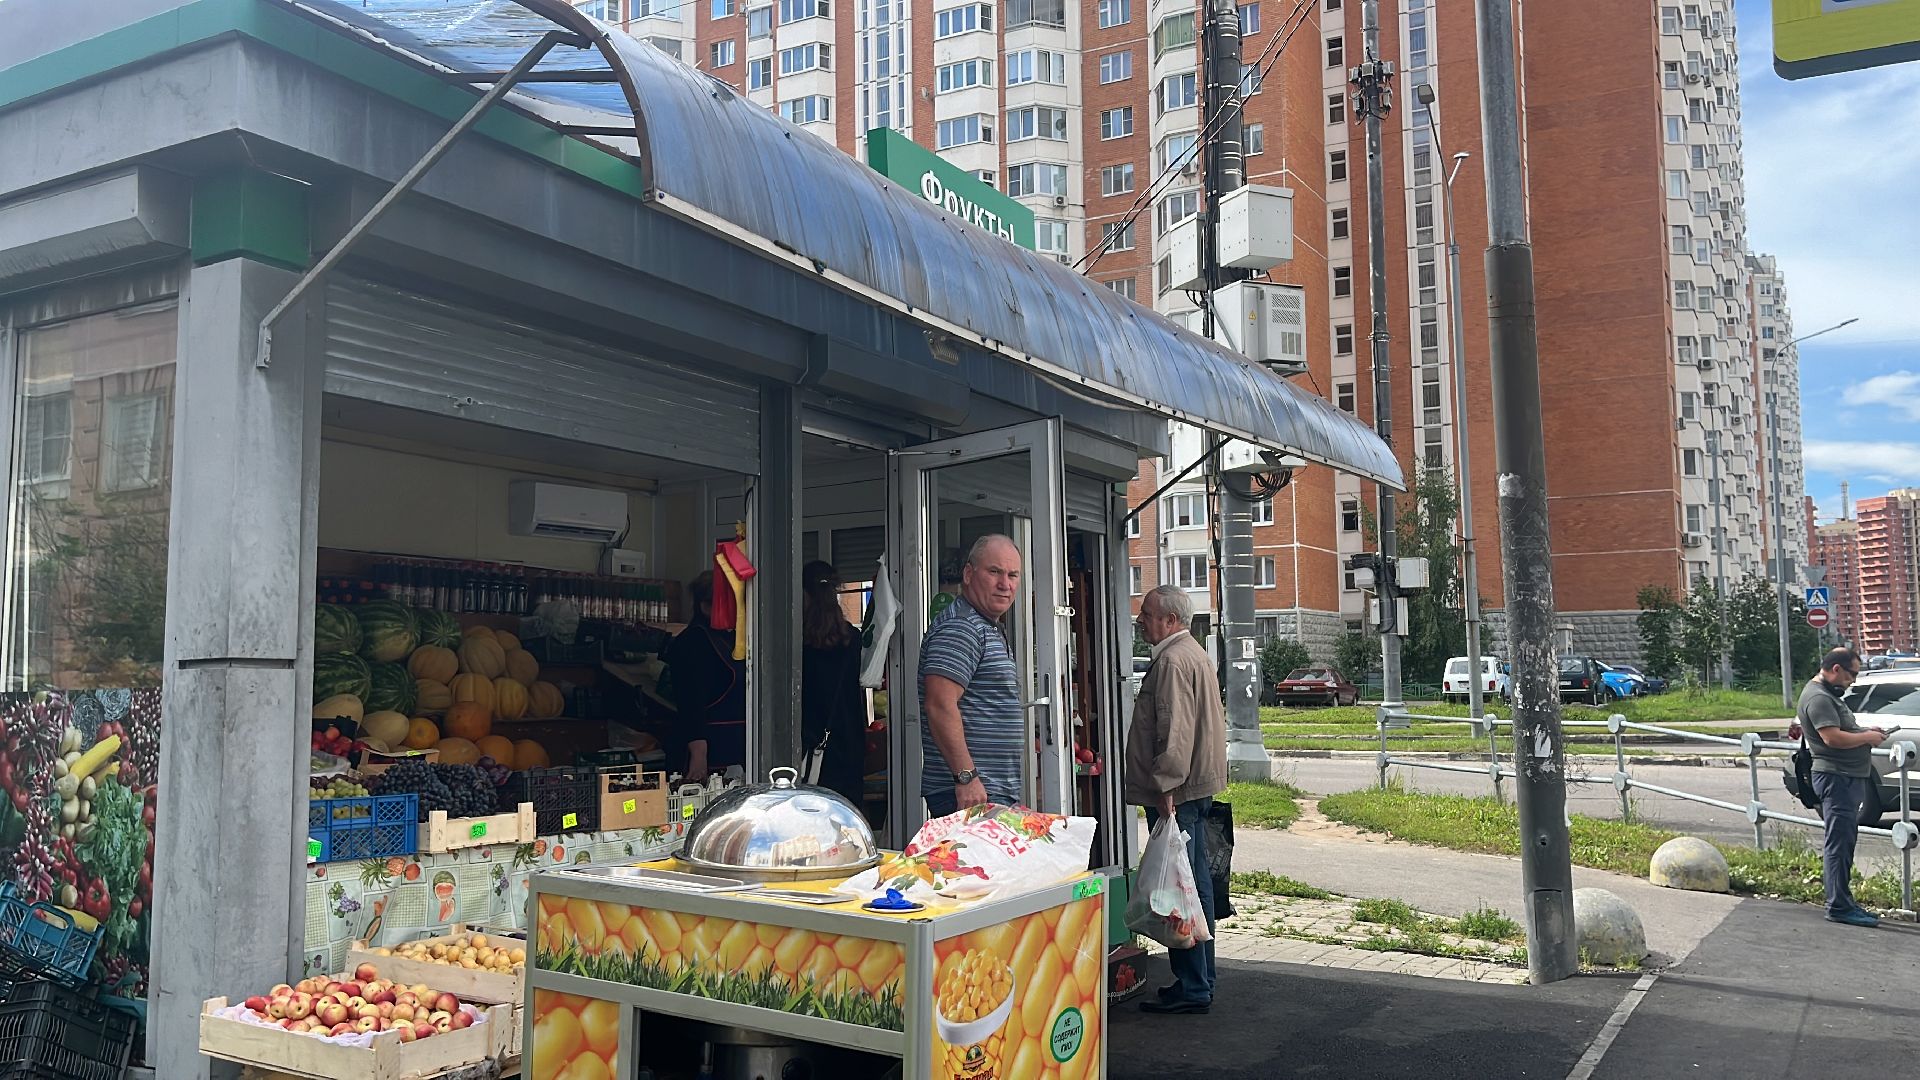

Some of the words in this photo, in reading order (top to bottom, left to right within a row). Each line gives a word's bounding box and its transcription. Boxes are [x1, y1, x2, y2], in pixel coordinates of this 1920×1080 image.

[920, 170, 1015, 244] Фрукты
[1063, 1017, 1071, 1027] НЕ
[1054, 1025, 1080, 1043] СОДЕРЖИТ
